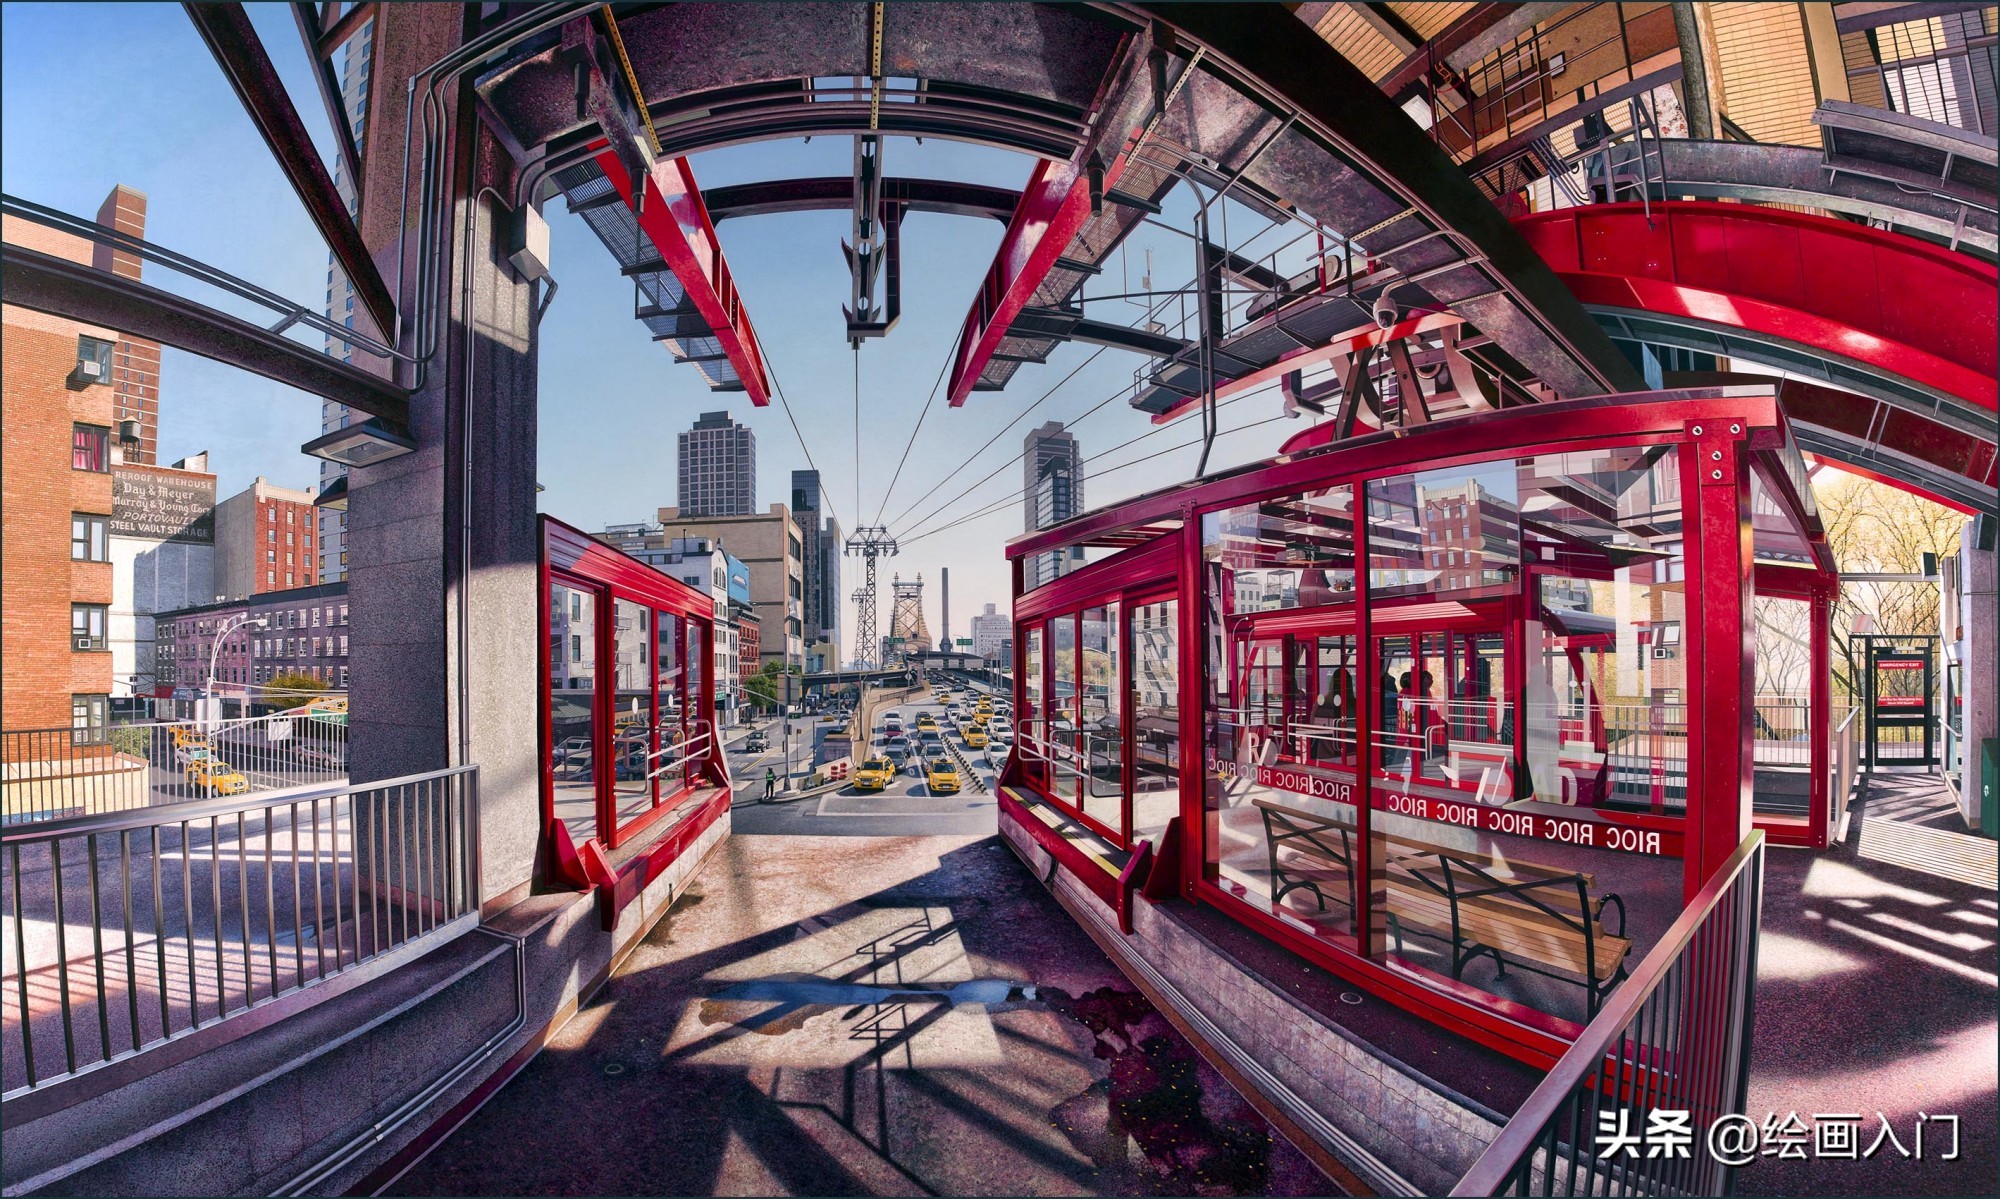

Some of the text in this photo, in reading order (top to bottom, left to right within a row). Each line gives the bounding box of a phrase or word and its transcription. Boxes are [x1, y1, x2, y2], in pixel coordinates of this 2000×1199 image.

[156, 475, 213, 490] WAREHOUSE
[123, 481, 195, 504] Day & Meyer
[112, 496, 150, 512] Murray
[150, 500, 157, 509] &
[158, 500, 189, 516] Young
[110, 520, 208, 537] STEEL VAULT STORAGE
